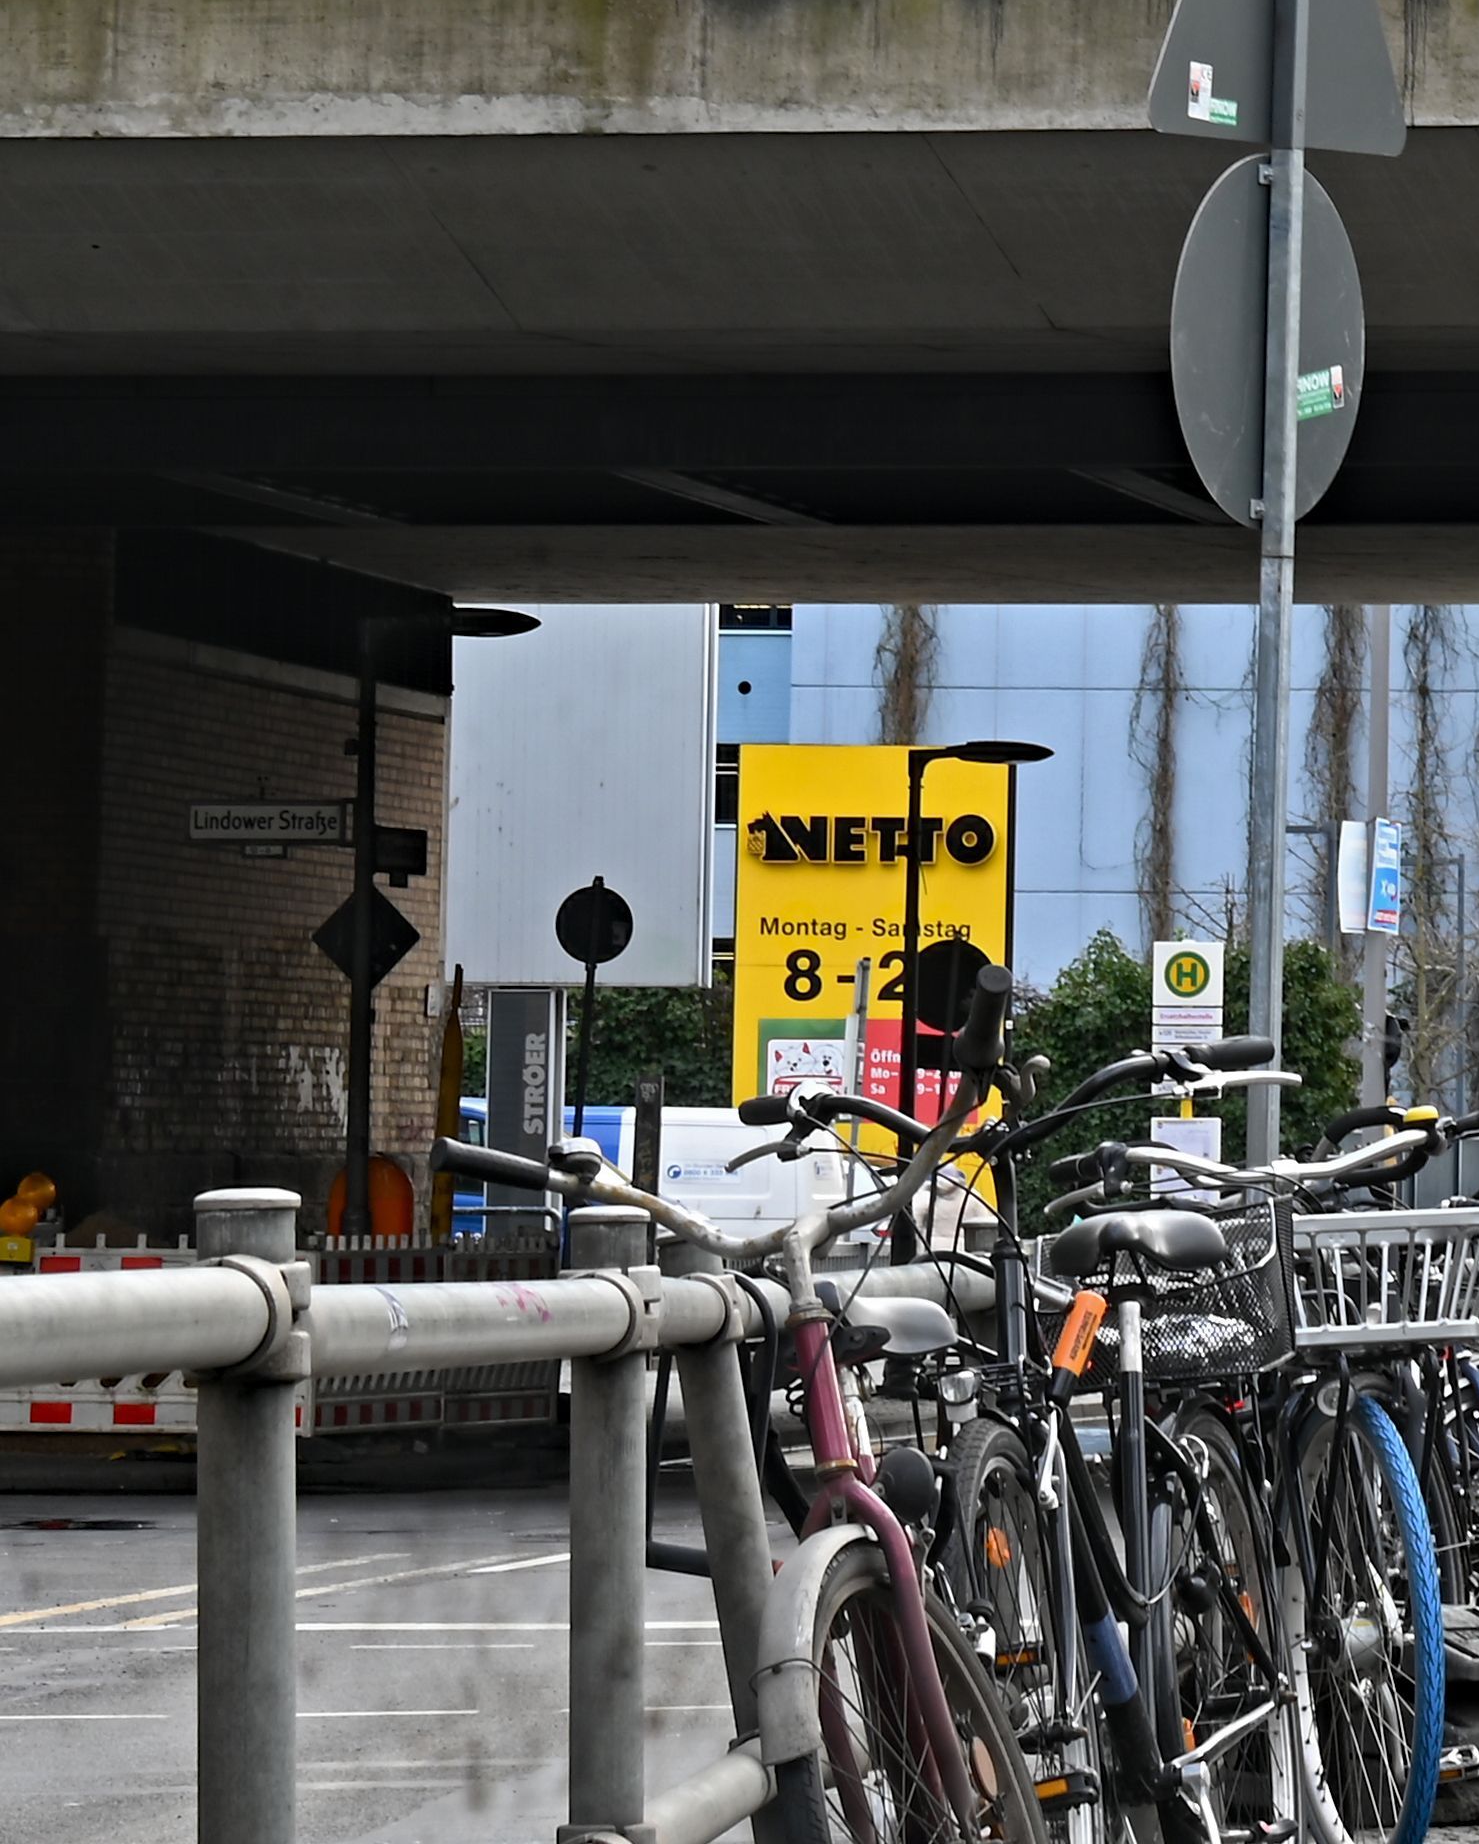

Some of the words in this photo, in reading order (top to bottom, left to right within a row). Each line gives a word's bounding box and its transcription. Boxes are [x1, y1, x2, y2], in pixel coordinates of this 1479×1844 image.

[194, 810, 275, 830] Lindower
[279, 810, 338, 835] Straße
[761, 814, 997, 865] NETTO
[760, 917, 847, 940] Montag
[872, 918, 971, 940] Sastag
[783, 949, 823, 1001] 8
[1176, 962, 1198, 987] H
[870, 1048, 902, 1063] Öffn
[522, 1032, 546, 1136] STRÖER
